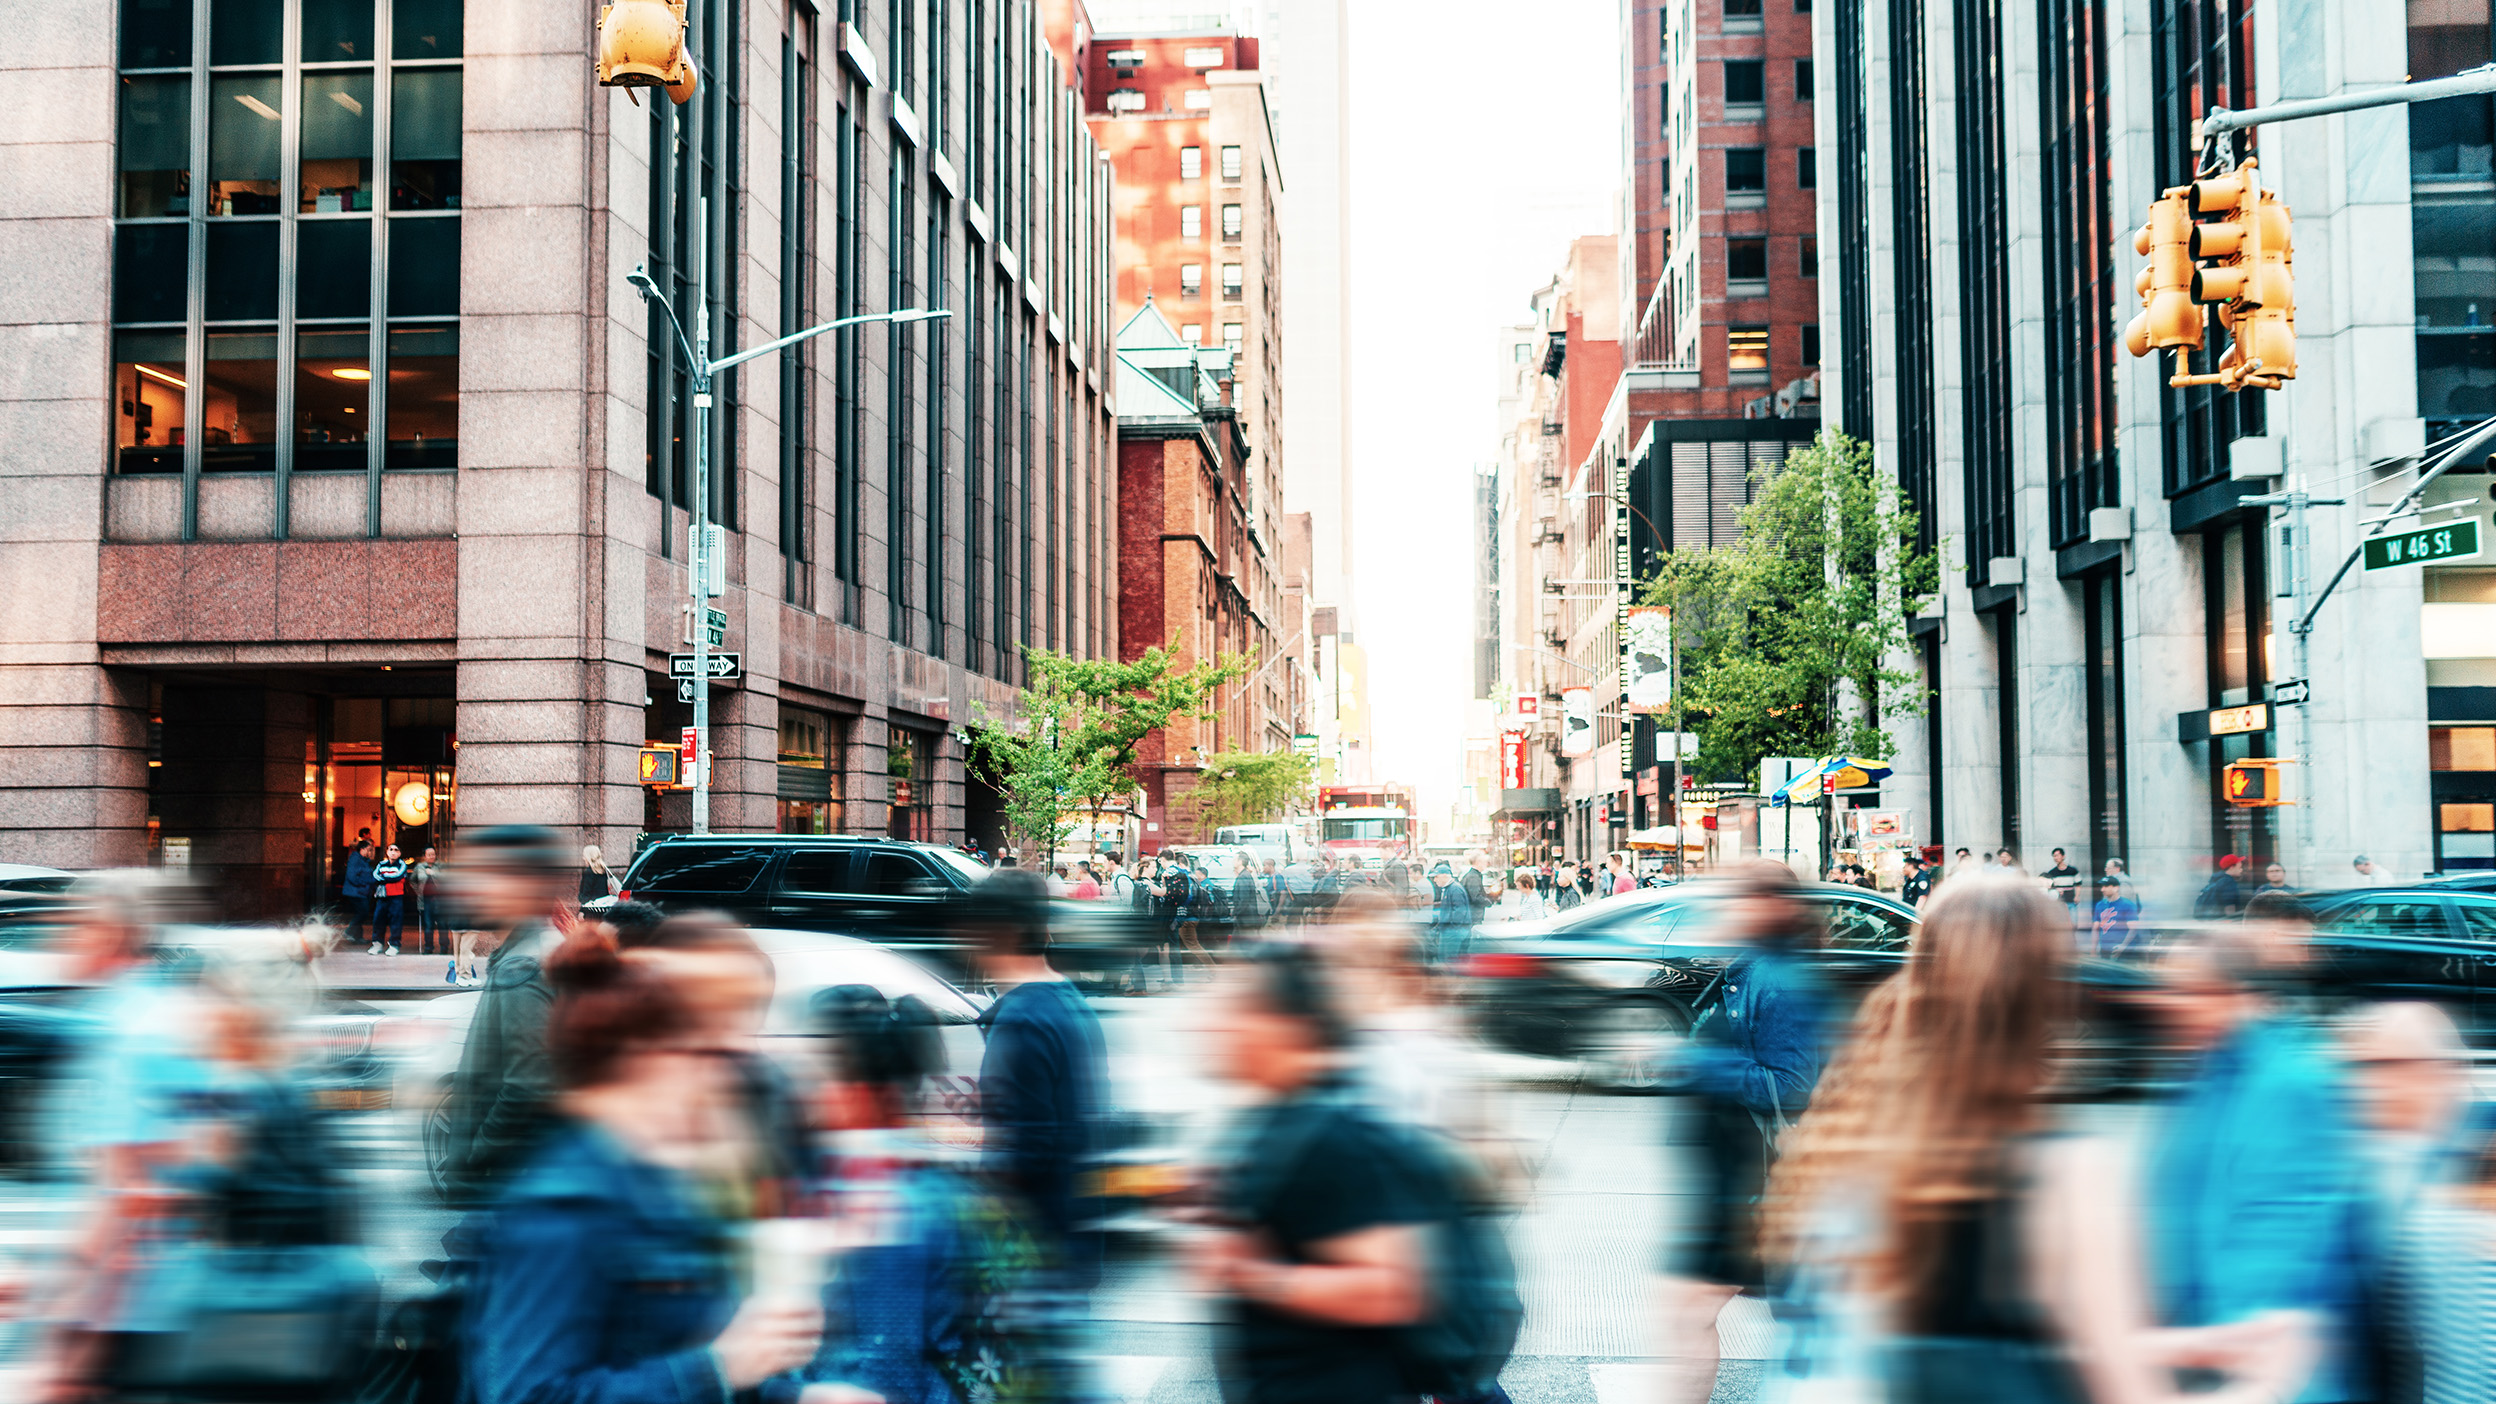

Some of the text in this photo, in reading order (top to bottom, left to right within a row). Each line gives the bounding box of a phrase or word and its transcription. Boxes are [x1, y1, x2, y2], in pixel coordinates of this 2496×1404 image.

[1617, 518, 1628, 537] FOR
[2385, 530, 2453, 562] W 46 St
[680, 661, 729, 671] ON WAY
